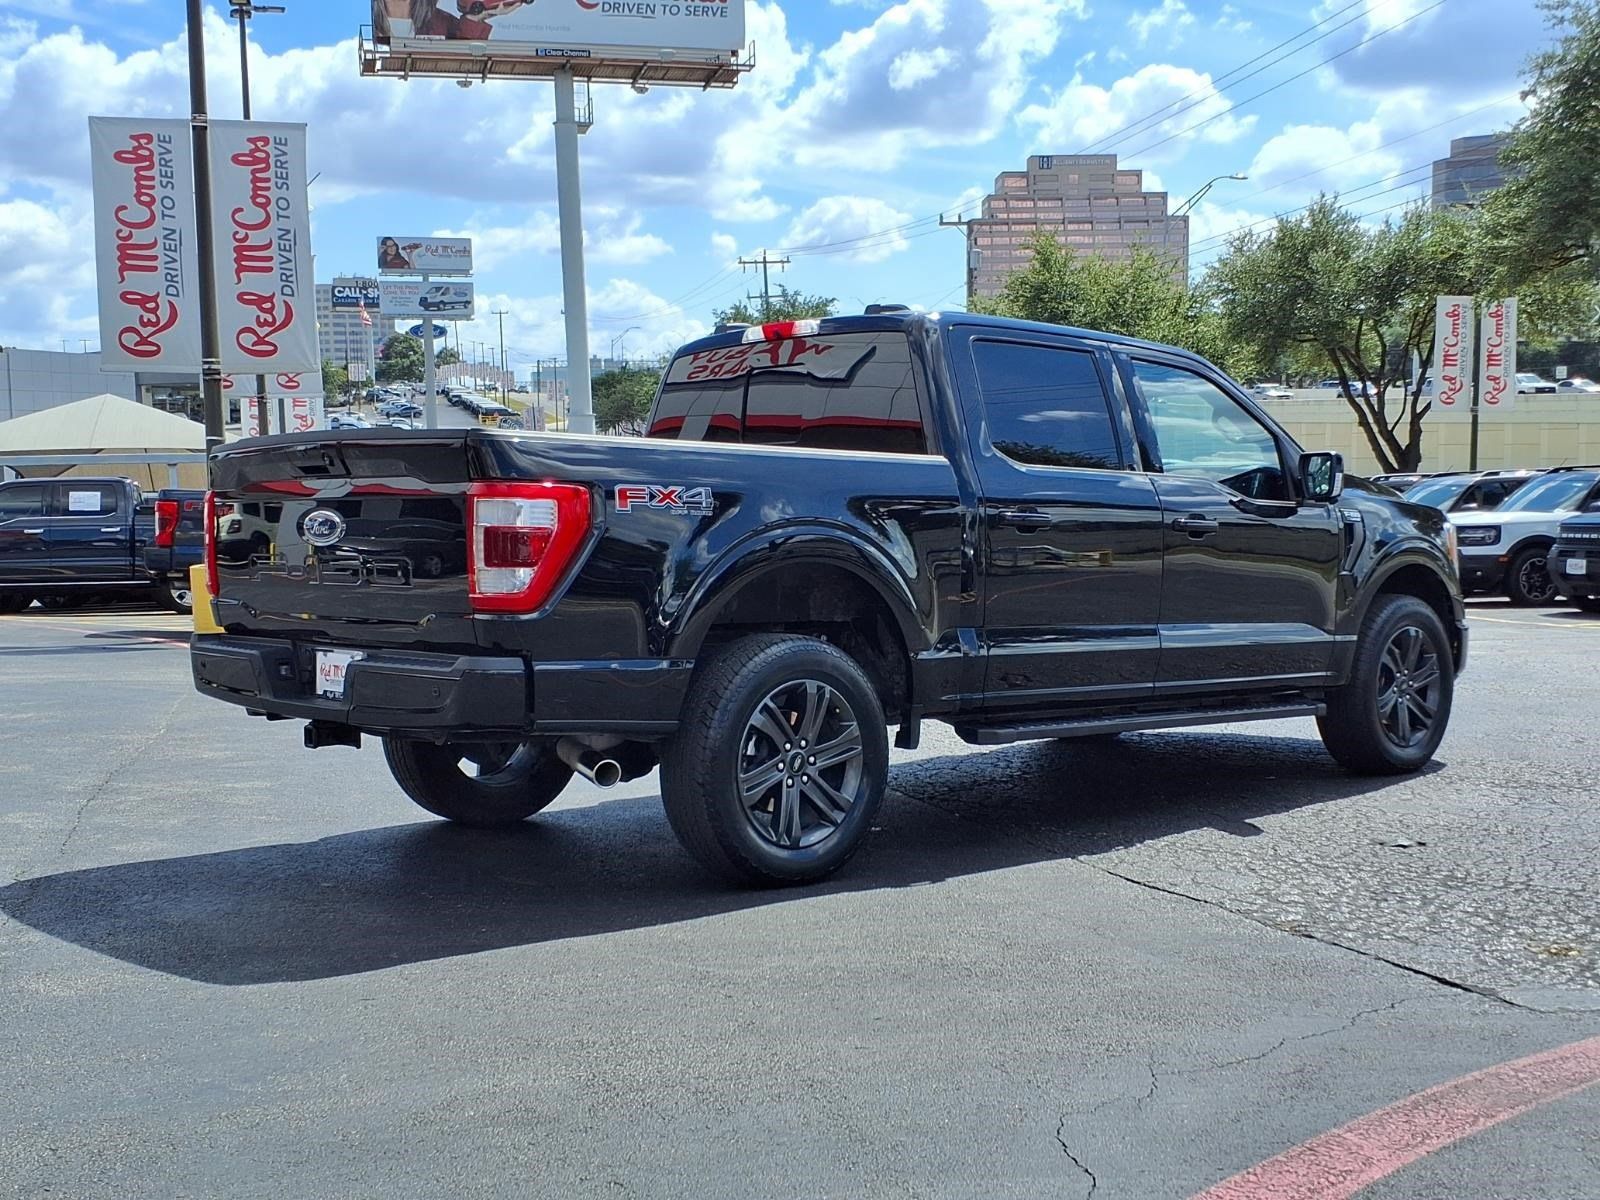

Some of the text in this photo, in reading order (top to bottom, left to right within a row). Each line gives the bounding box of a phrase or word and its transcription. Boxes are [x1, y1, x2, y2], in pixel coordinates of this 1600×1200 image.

[601, 2, 729, 18] DRIVEN TO SERVE
[563, 49, 589, 57] Channel
[113, 132, 178, 358] Red McCombs
[157, 133, 181, 298] DRIVEN TO SERVE
[231, 135, 274, 285] McCombs
[274, 136, 296, 298] DRIVEN TO SERVE
[235, 291, 293, 358] Red
[1439, 304, 1463, 405] Red McCombs
[1459, 347, 1467, 378] DRIVEN
[1484, 303, 1507, 405] Red McCombs
[1502, 347, 1510, 378] DRIVEN
[615, 483, 714, 513] FX4
